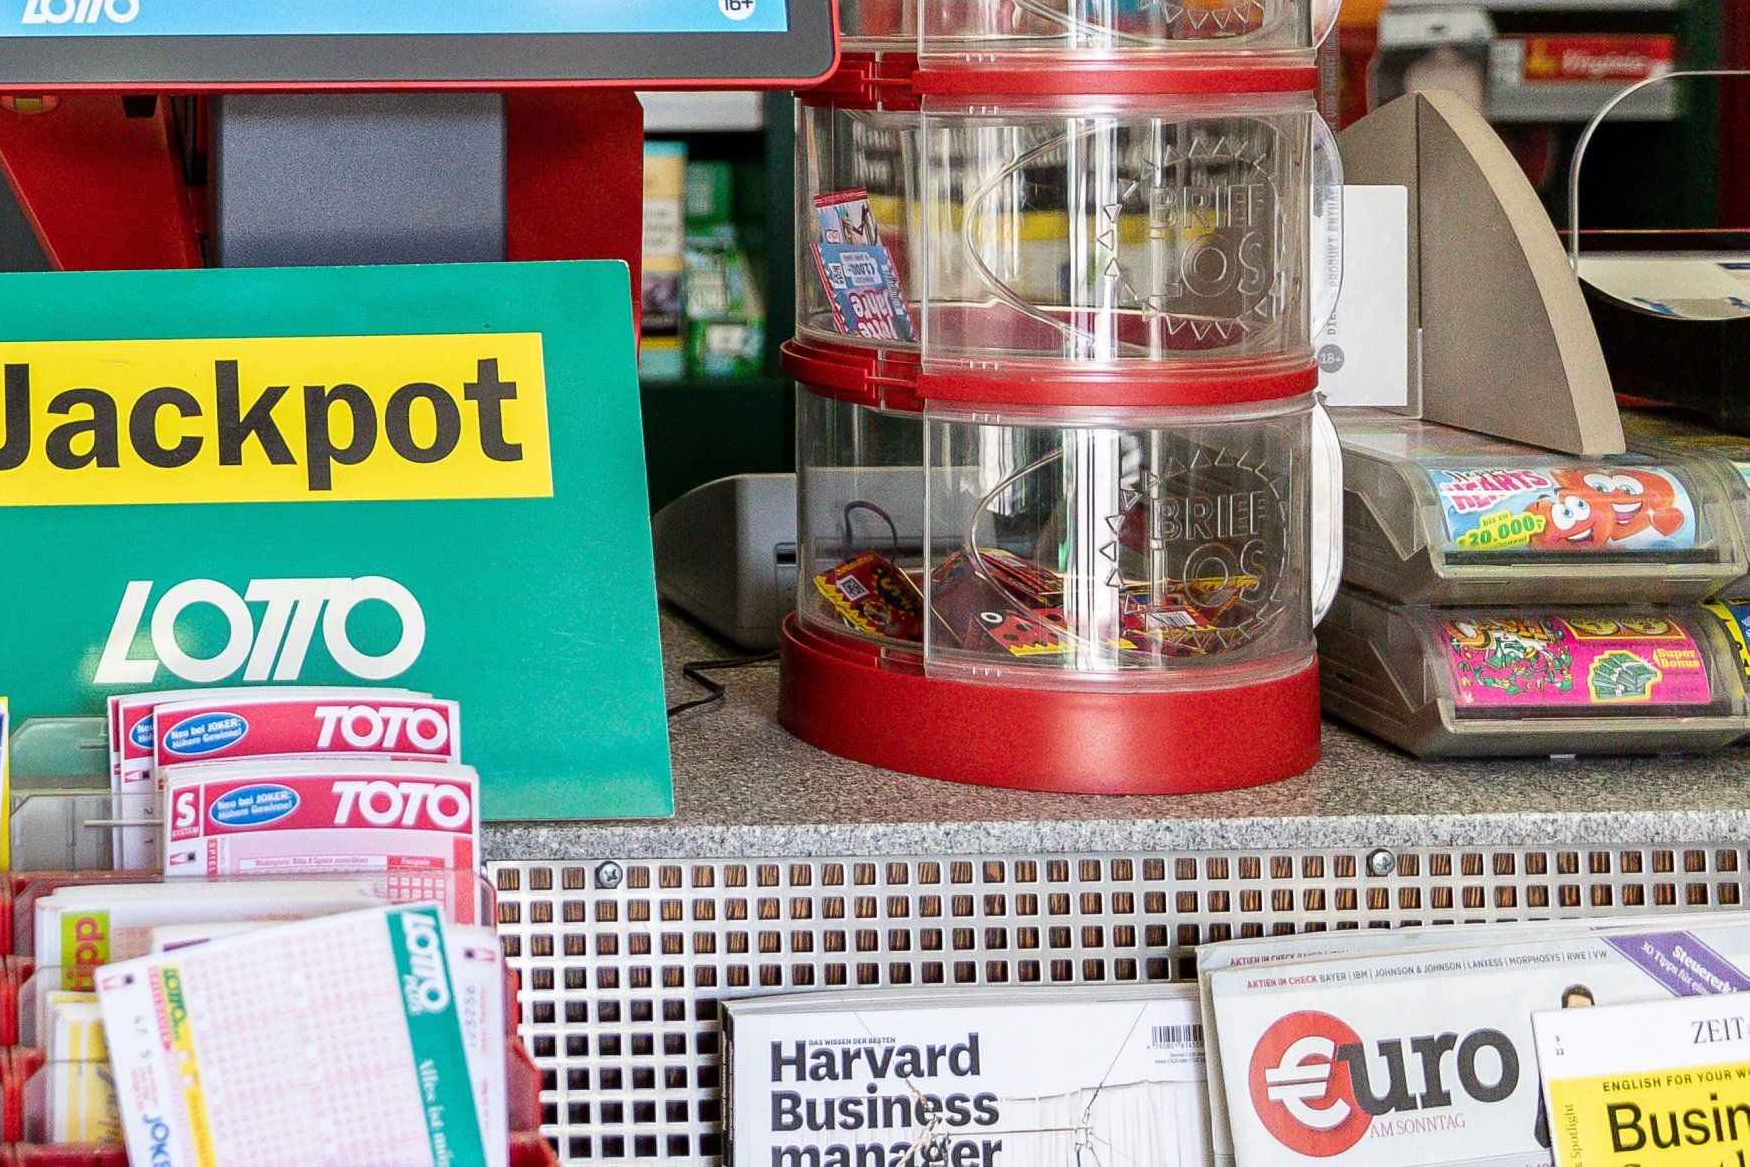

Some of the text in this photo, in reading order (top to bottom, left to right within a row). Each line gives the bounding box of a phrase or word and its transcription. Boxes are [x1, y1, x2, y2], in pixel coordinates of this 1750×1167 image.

[1150, 184, 1264, 229] BRIEF
[1320, 352, 1343, 365] 18+
[1153, 491, 1265, 541] BRIEF
[1153, 539, 1267, 607] LOS
[94, 576, 426, 684] LOTTO
[171, 718, 241, 740] Neu bei JOKER:
[314, 705, 448, 750] TOTO
[176, 791, 196, 827] S
[218, 791, 292, 809] Neu bei JOKER:
[331, 780, 470, 828] TOTO
[1247, 950, 1608, 990] AKTIEN IM CHECK BAYER IBM JOHNSON JOHNSON LANXESS MORPHOSYS RWE VW
[770, 1032, 981, 1082] Harvard
[825, 1038, 850, 1046] WISSEN
[852, 1037, 867, 1045] DER
[868, 1036, 896, 1044] BESTEN
[1603, 1070, 1732, 1092] ENGLISH FOR YOUR
[771, 1083, 999, 1132] Business
[1370, 1113, 1466, 1139] AM SONNTAG
[1565, 1103, 1582, 1159] Spotlight
[771, 1139, 1002, 1167] manager
